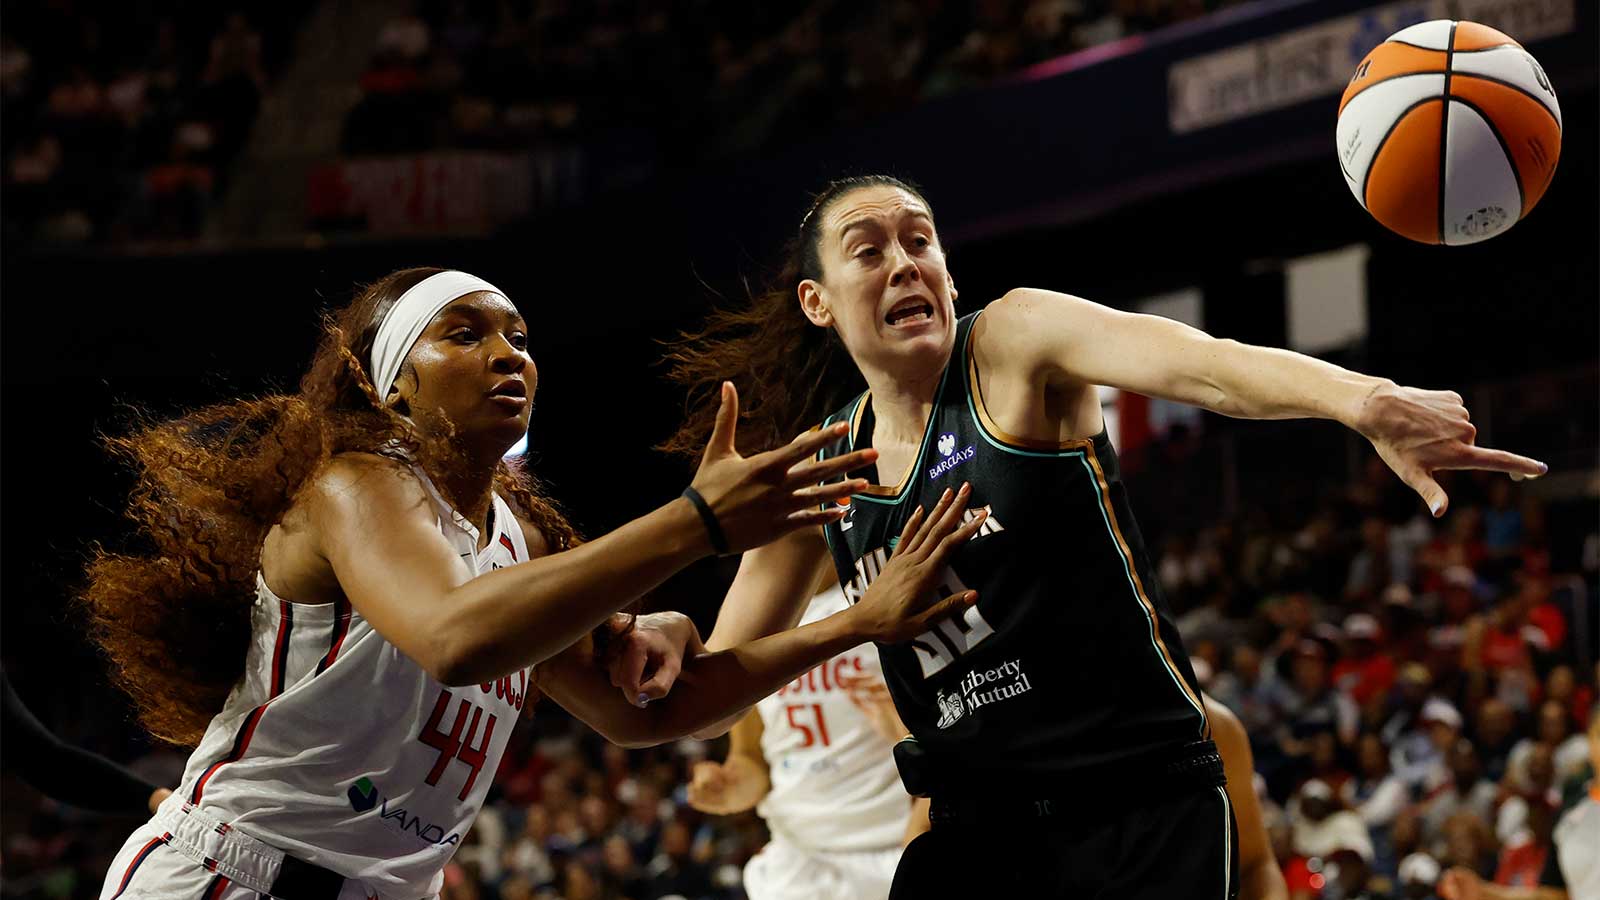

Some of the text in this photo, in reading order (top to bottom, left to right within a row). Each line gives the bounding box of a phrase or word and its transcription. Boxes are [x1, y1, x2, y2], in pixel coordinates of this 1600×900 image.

[929, 446, 974, 479] BARCLAYS
[960, 659, 1020, 697] Liberty
[966, 673, 1032, 716] Mutual
[418, 690, 497, 801] 44
[785, 704, 831, 749] 51
[379, 798, 460, 846] VANDA
